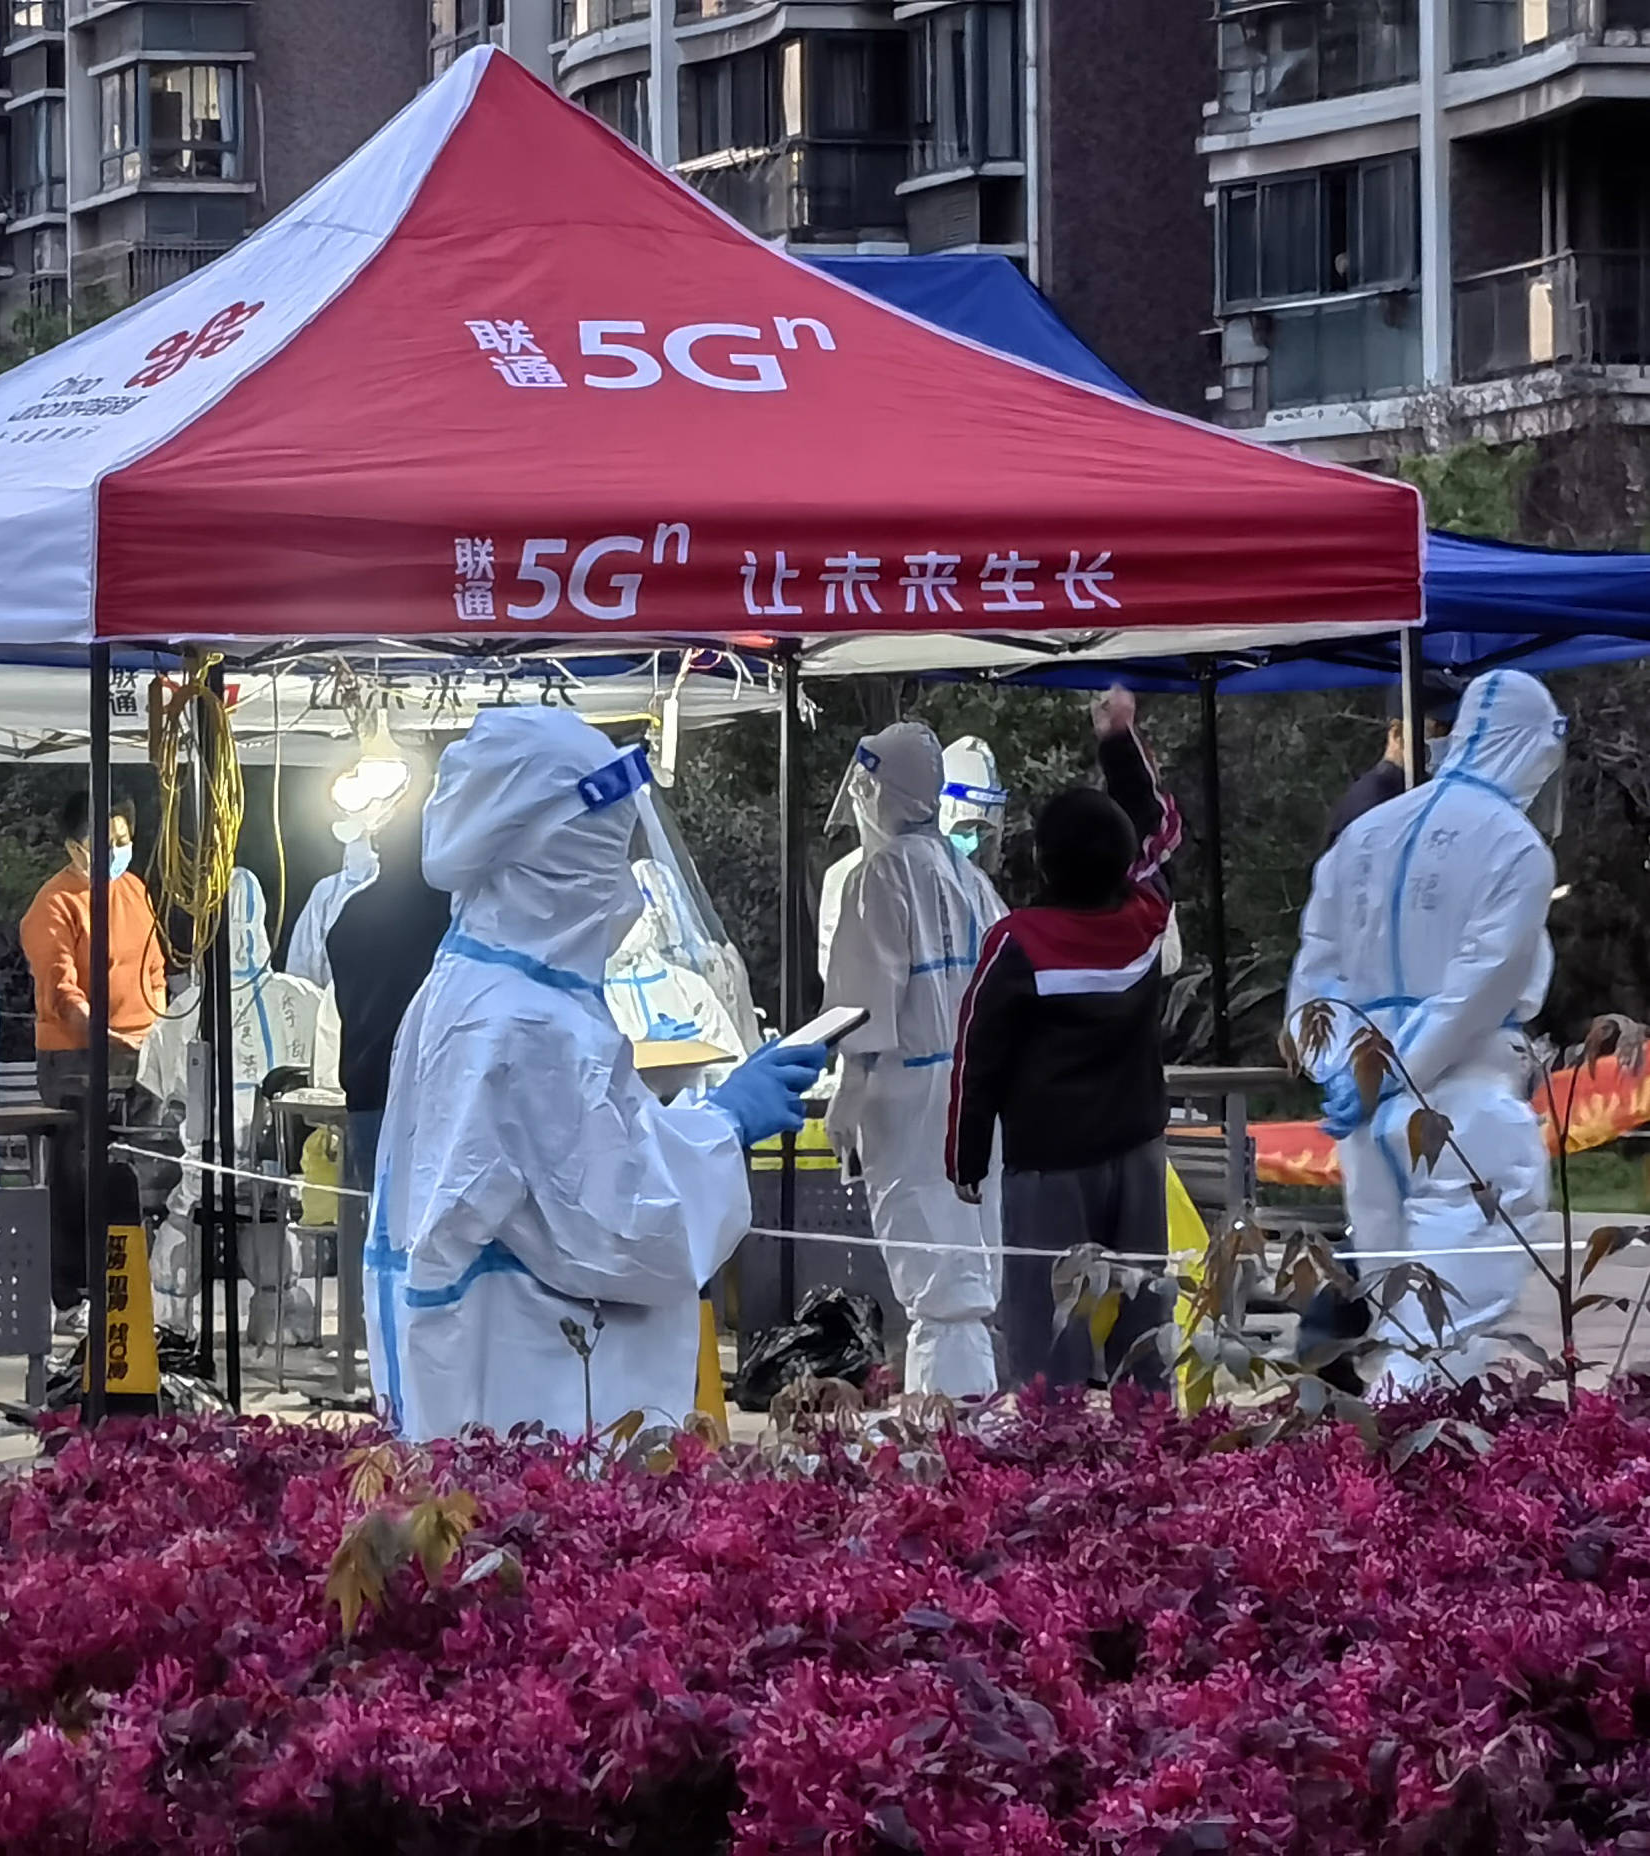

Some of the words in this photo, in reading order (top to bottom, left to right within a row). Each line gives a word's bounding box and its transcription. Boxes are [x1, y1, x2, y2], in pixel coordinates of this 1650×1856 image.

[465, 319, 568, 388] 联通
[454, 537, 496, 621] 联通
[740, 551, 1121, 616] 让未来生长
